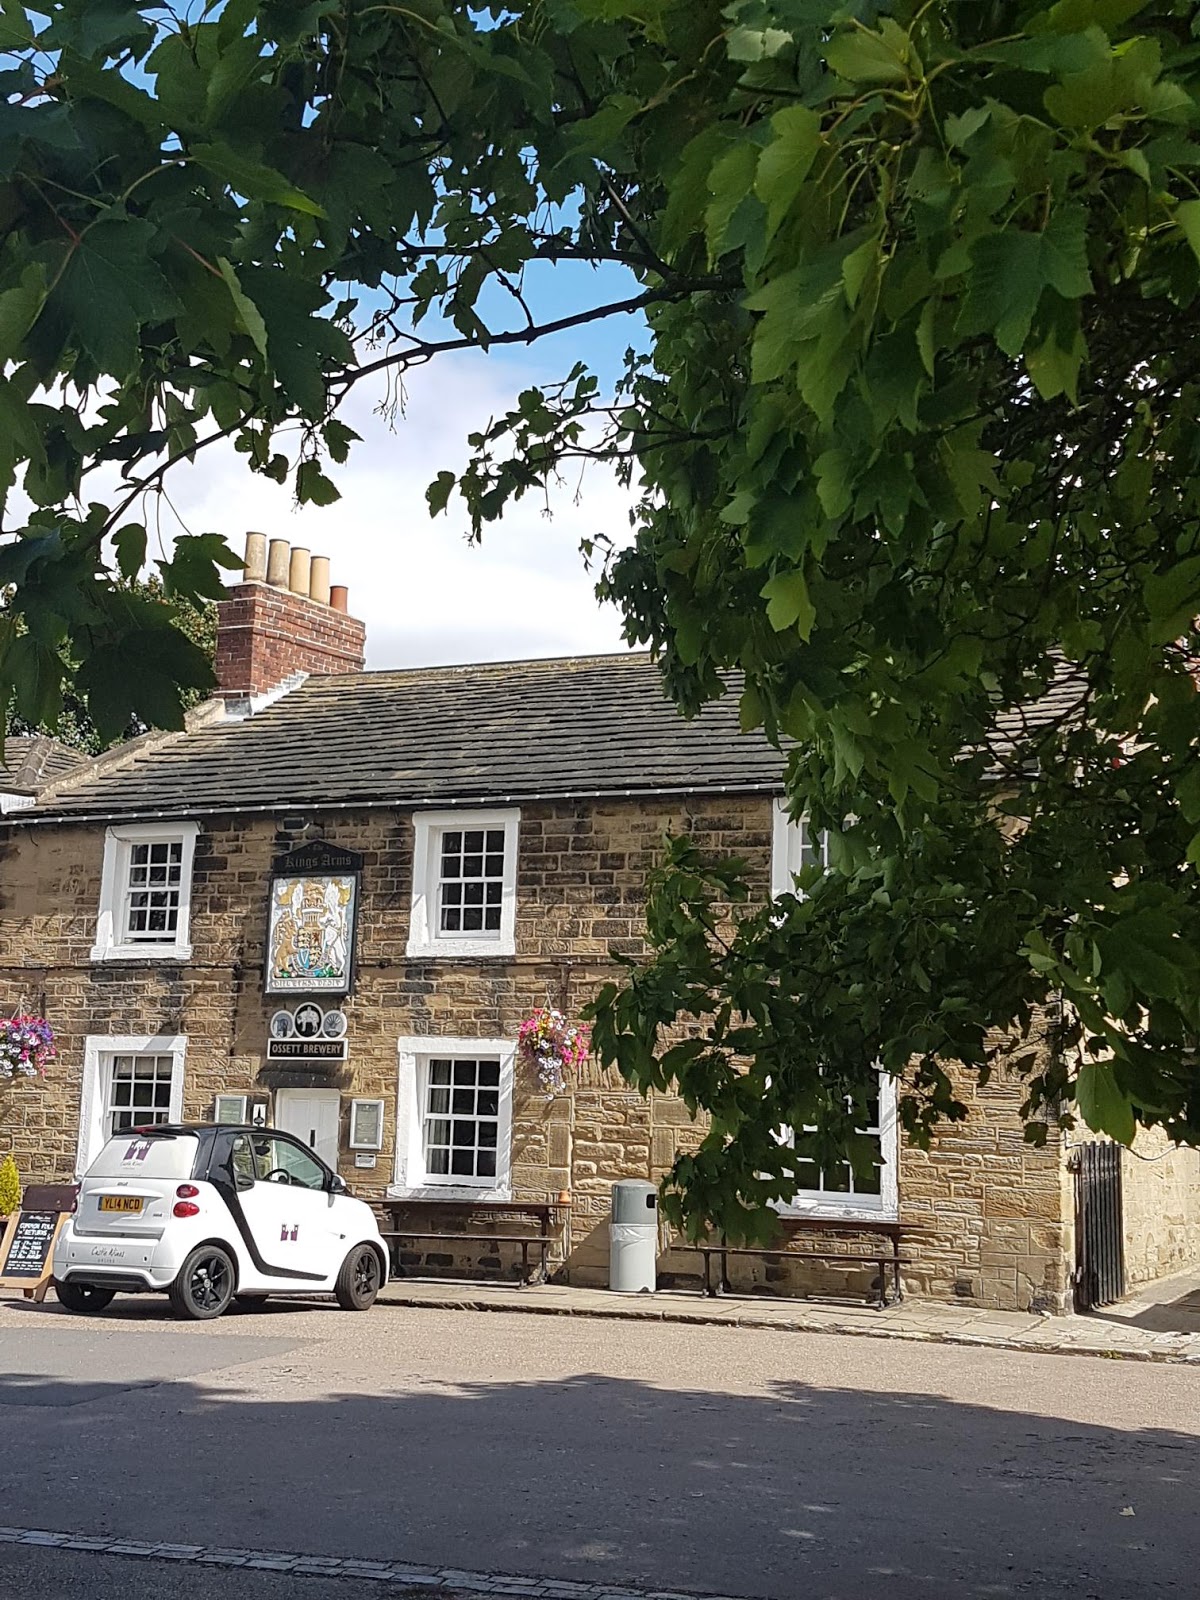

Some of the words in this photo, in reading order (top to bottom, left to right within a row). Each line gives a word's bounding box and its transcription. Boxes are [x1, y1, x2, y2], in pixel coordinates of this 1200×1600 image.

[285, 855, 318, 869] Kings
[321, 853, 352, 866] Arms
[272, 1044, 301, 1053] OSSETT
[303, 1044, 342, 1053] BREWERY
[104, 1198, 121, 1208] YL14
[124, 1199, 140, 1209] NCD
